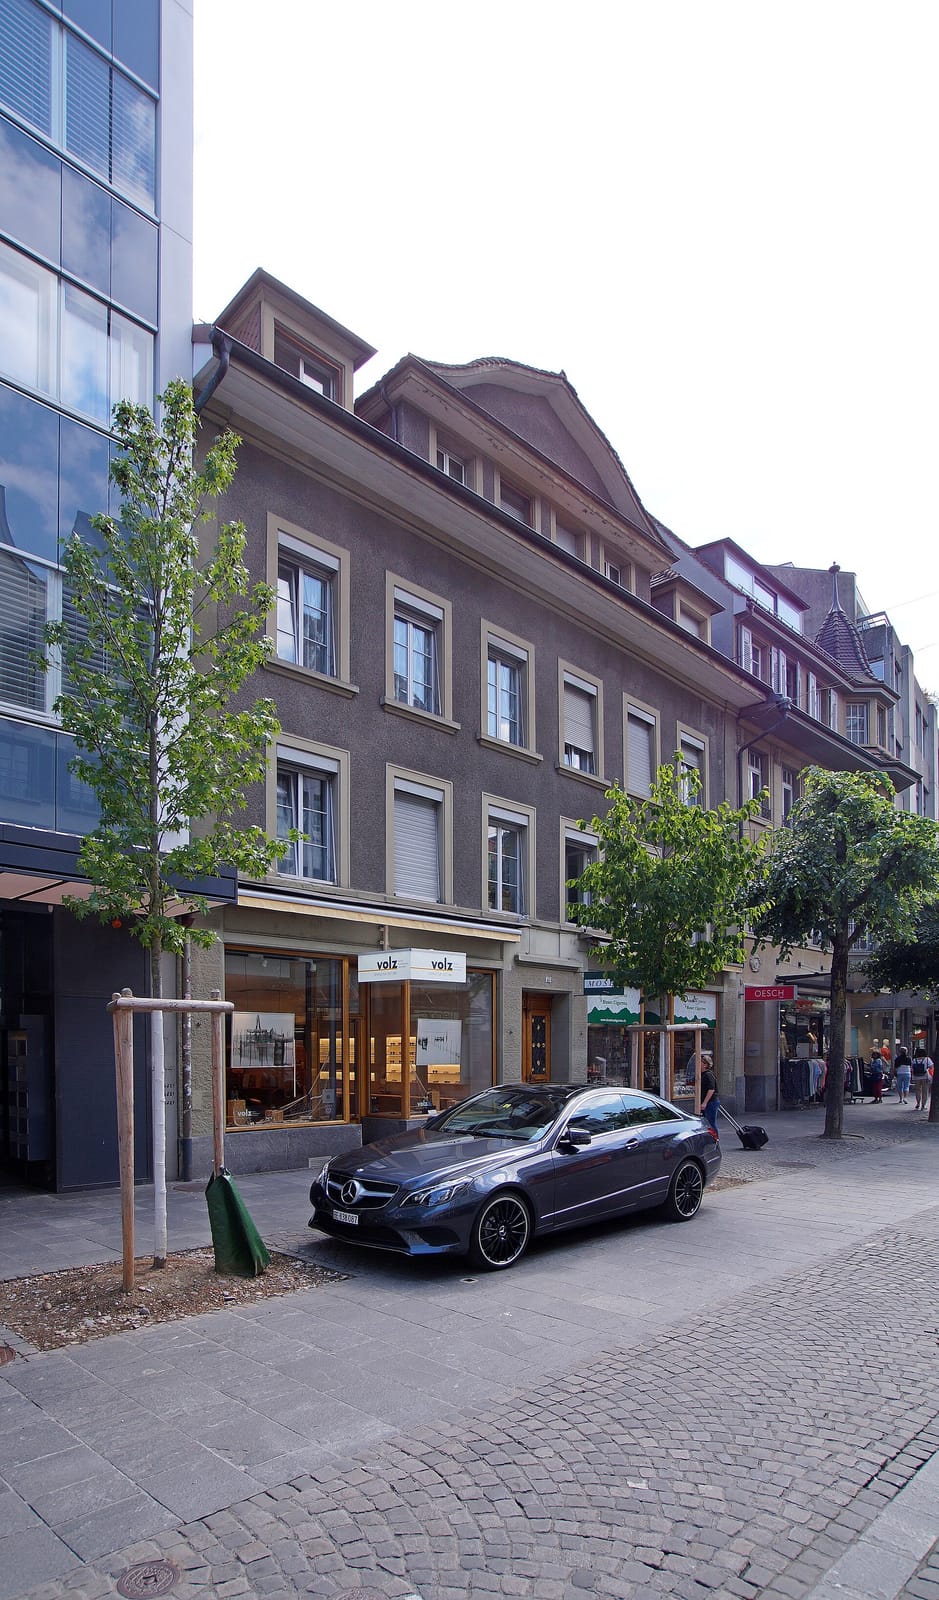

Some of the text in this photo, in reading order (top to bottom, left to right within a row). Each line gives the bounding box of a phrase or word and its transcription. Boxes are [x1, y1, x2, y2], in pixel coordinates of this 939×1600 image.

[377, 956, 398, 970] volz
[431, 957, 453, 971] volz
[237, 1109, 252, 1117] volz
